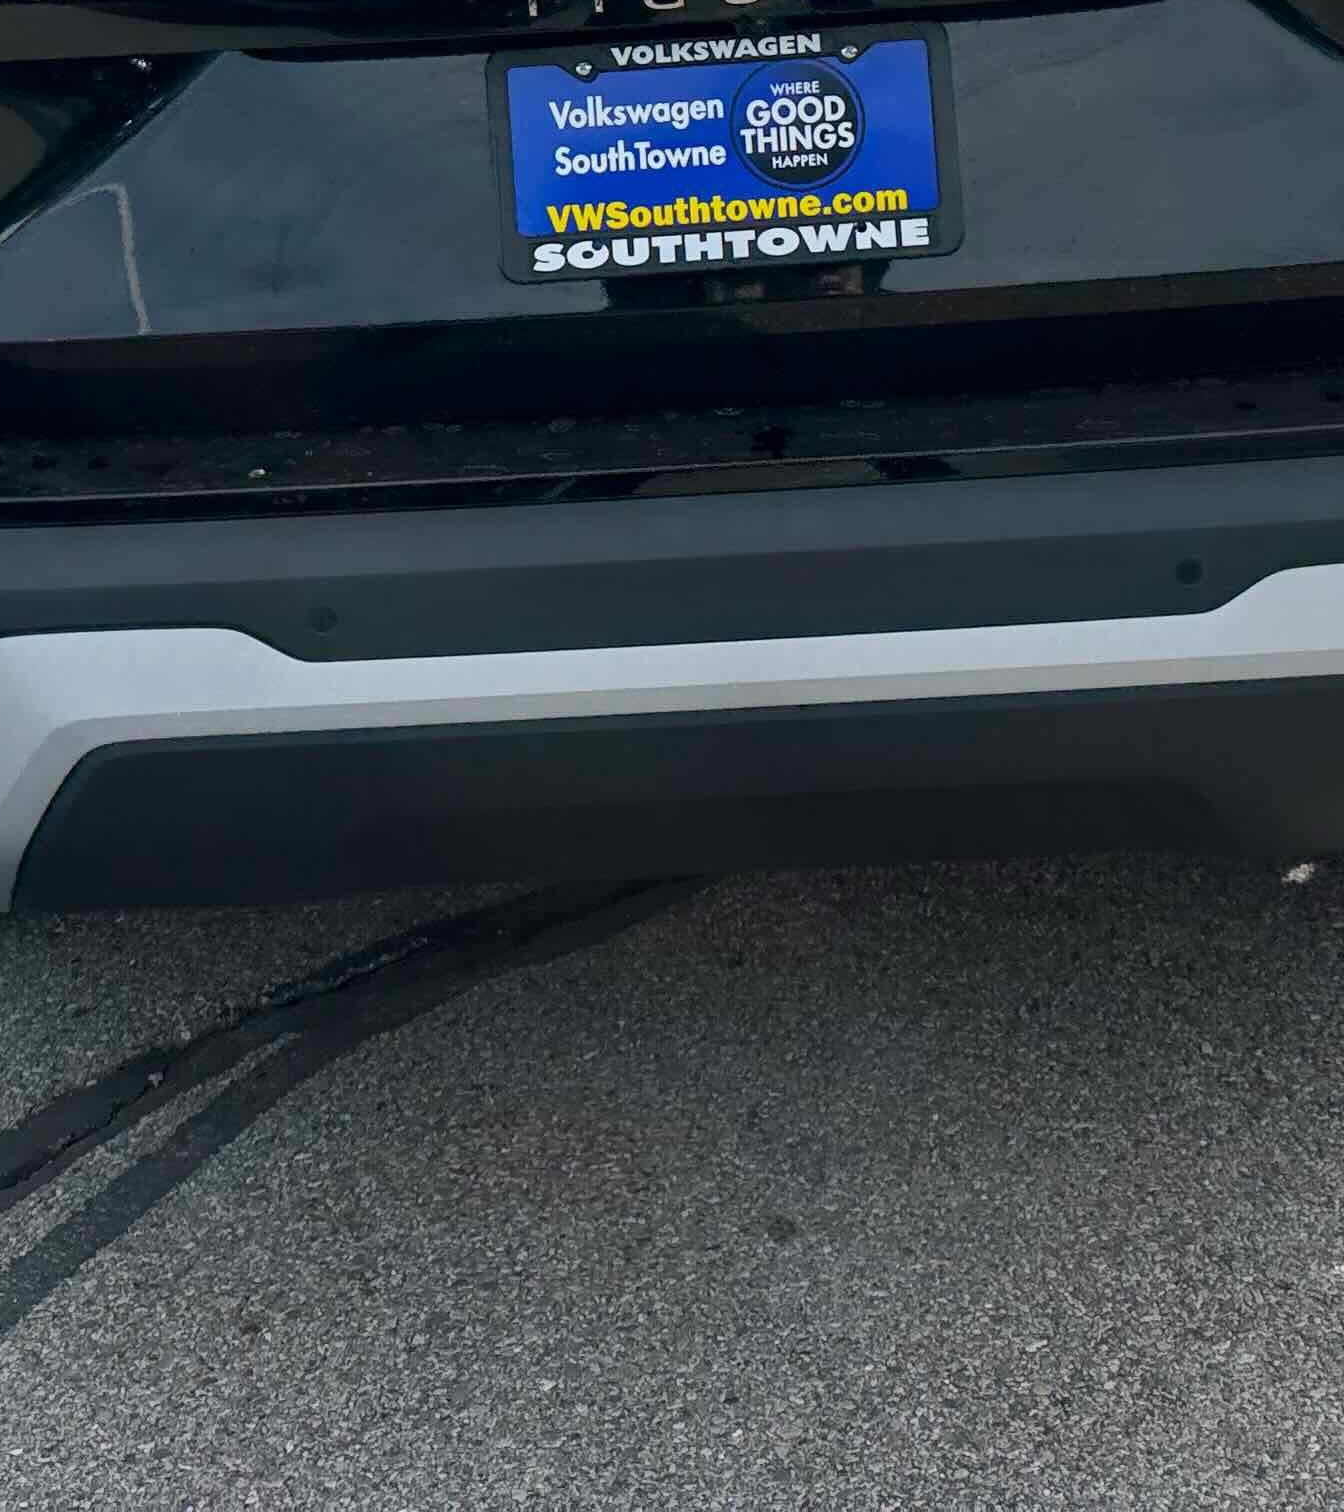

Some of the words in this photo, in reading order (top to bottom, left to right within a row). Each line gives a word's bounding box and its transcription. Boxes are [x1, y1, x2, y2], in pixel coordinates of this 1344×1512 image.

[610, 34, 821, 67] VOLKSWAGEN
[770, 80, 820, 96] WHERE
[549, 96, 724, 130] Volkswagen
[746, 96, 846, 127] GOOD
[740, 122, 855, 155] THINGS
[555, 142, 727, 176] SouthTowne
[771, 152, 828, 169] HAPPEN
[547, 188, 908, 233] VWSouthtowne.com
[533, 218, 930, 272] SOUTHTOWNE
